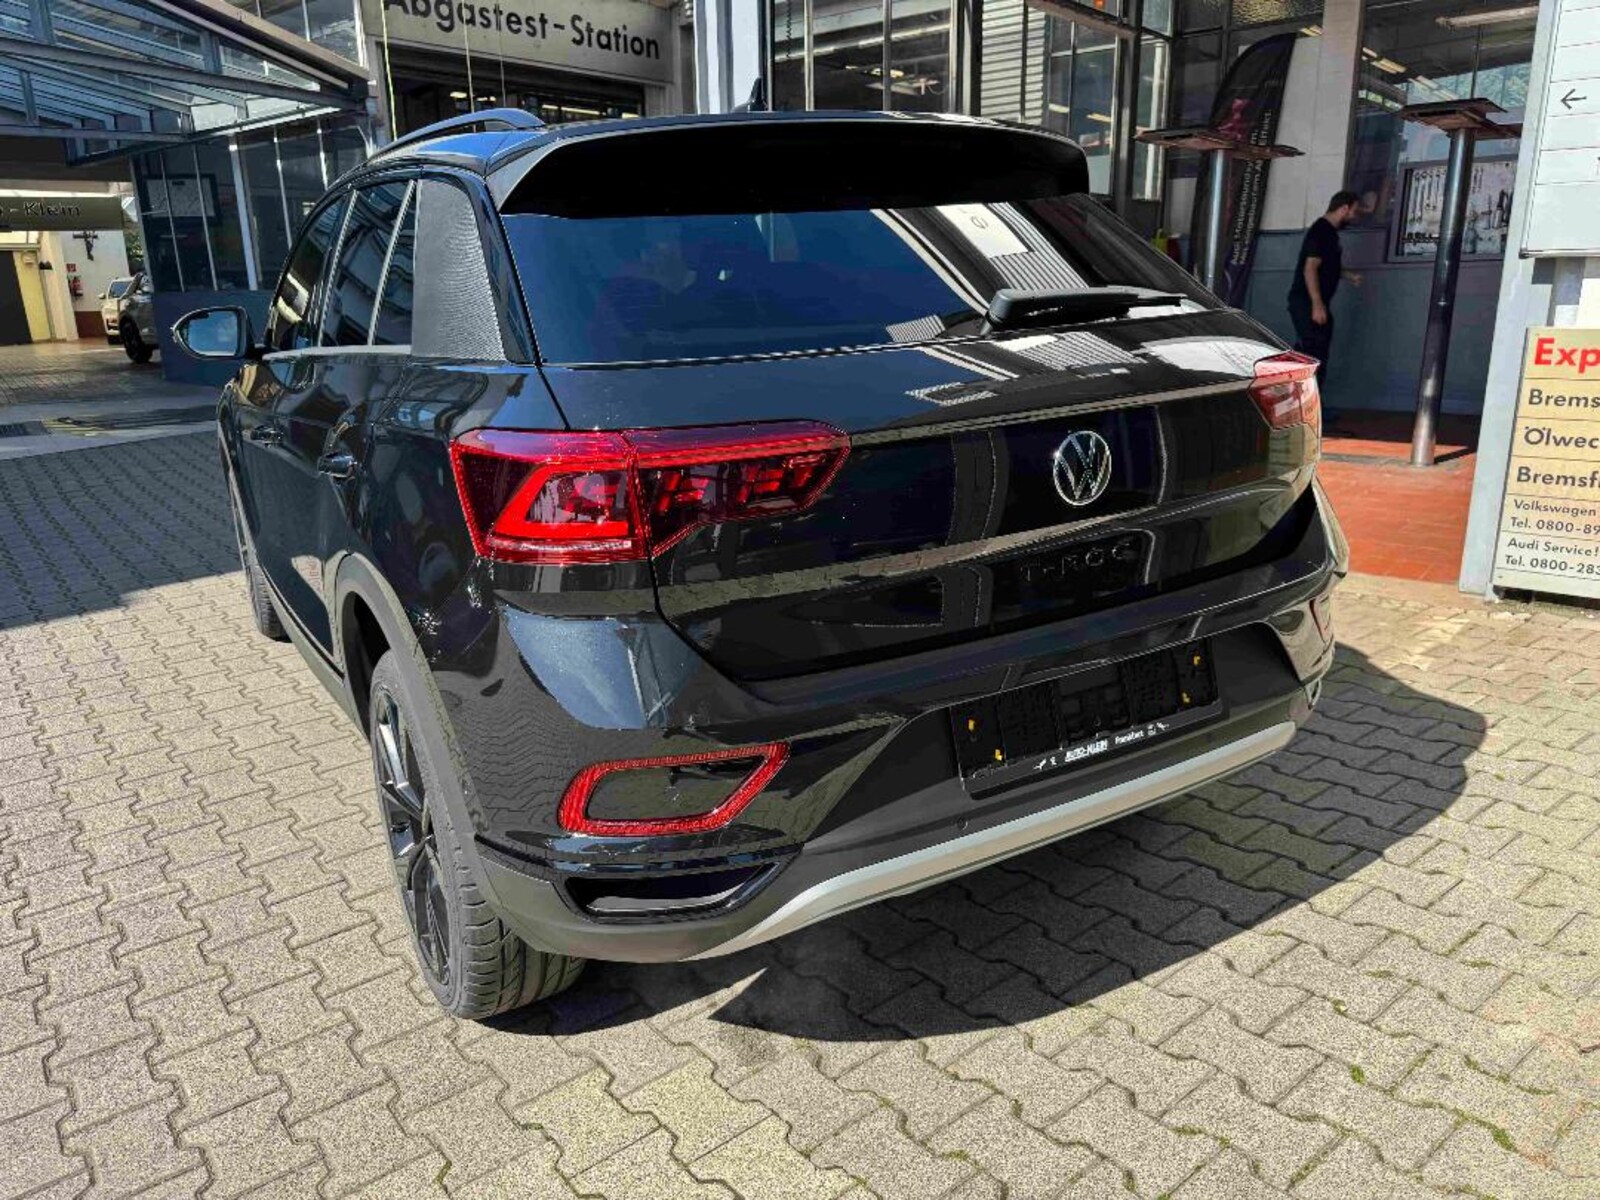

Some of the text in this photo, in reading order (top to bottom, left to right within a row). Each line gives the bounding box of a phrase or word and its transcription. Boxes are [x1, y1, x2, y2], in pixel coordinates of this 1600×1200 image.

[1534, 337, 1600, 373] Exp
[1528, 388, 1600, 408] Brems
[1524, 426, 1600, 449] Ölwec
[1514, 499, 1597, 517] Volkswagen
[1511, 516, 1600, 535] Tel. 0800-89
[1508, 537, 1540, 550] Audi
[1506, 555, 1525, 567] Tel.
